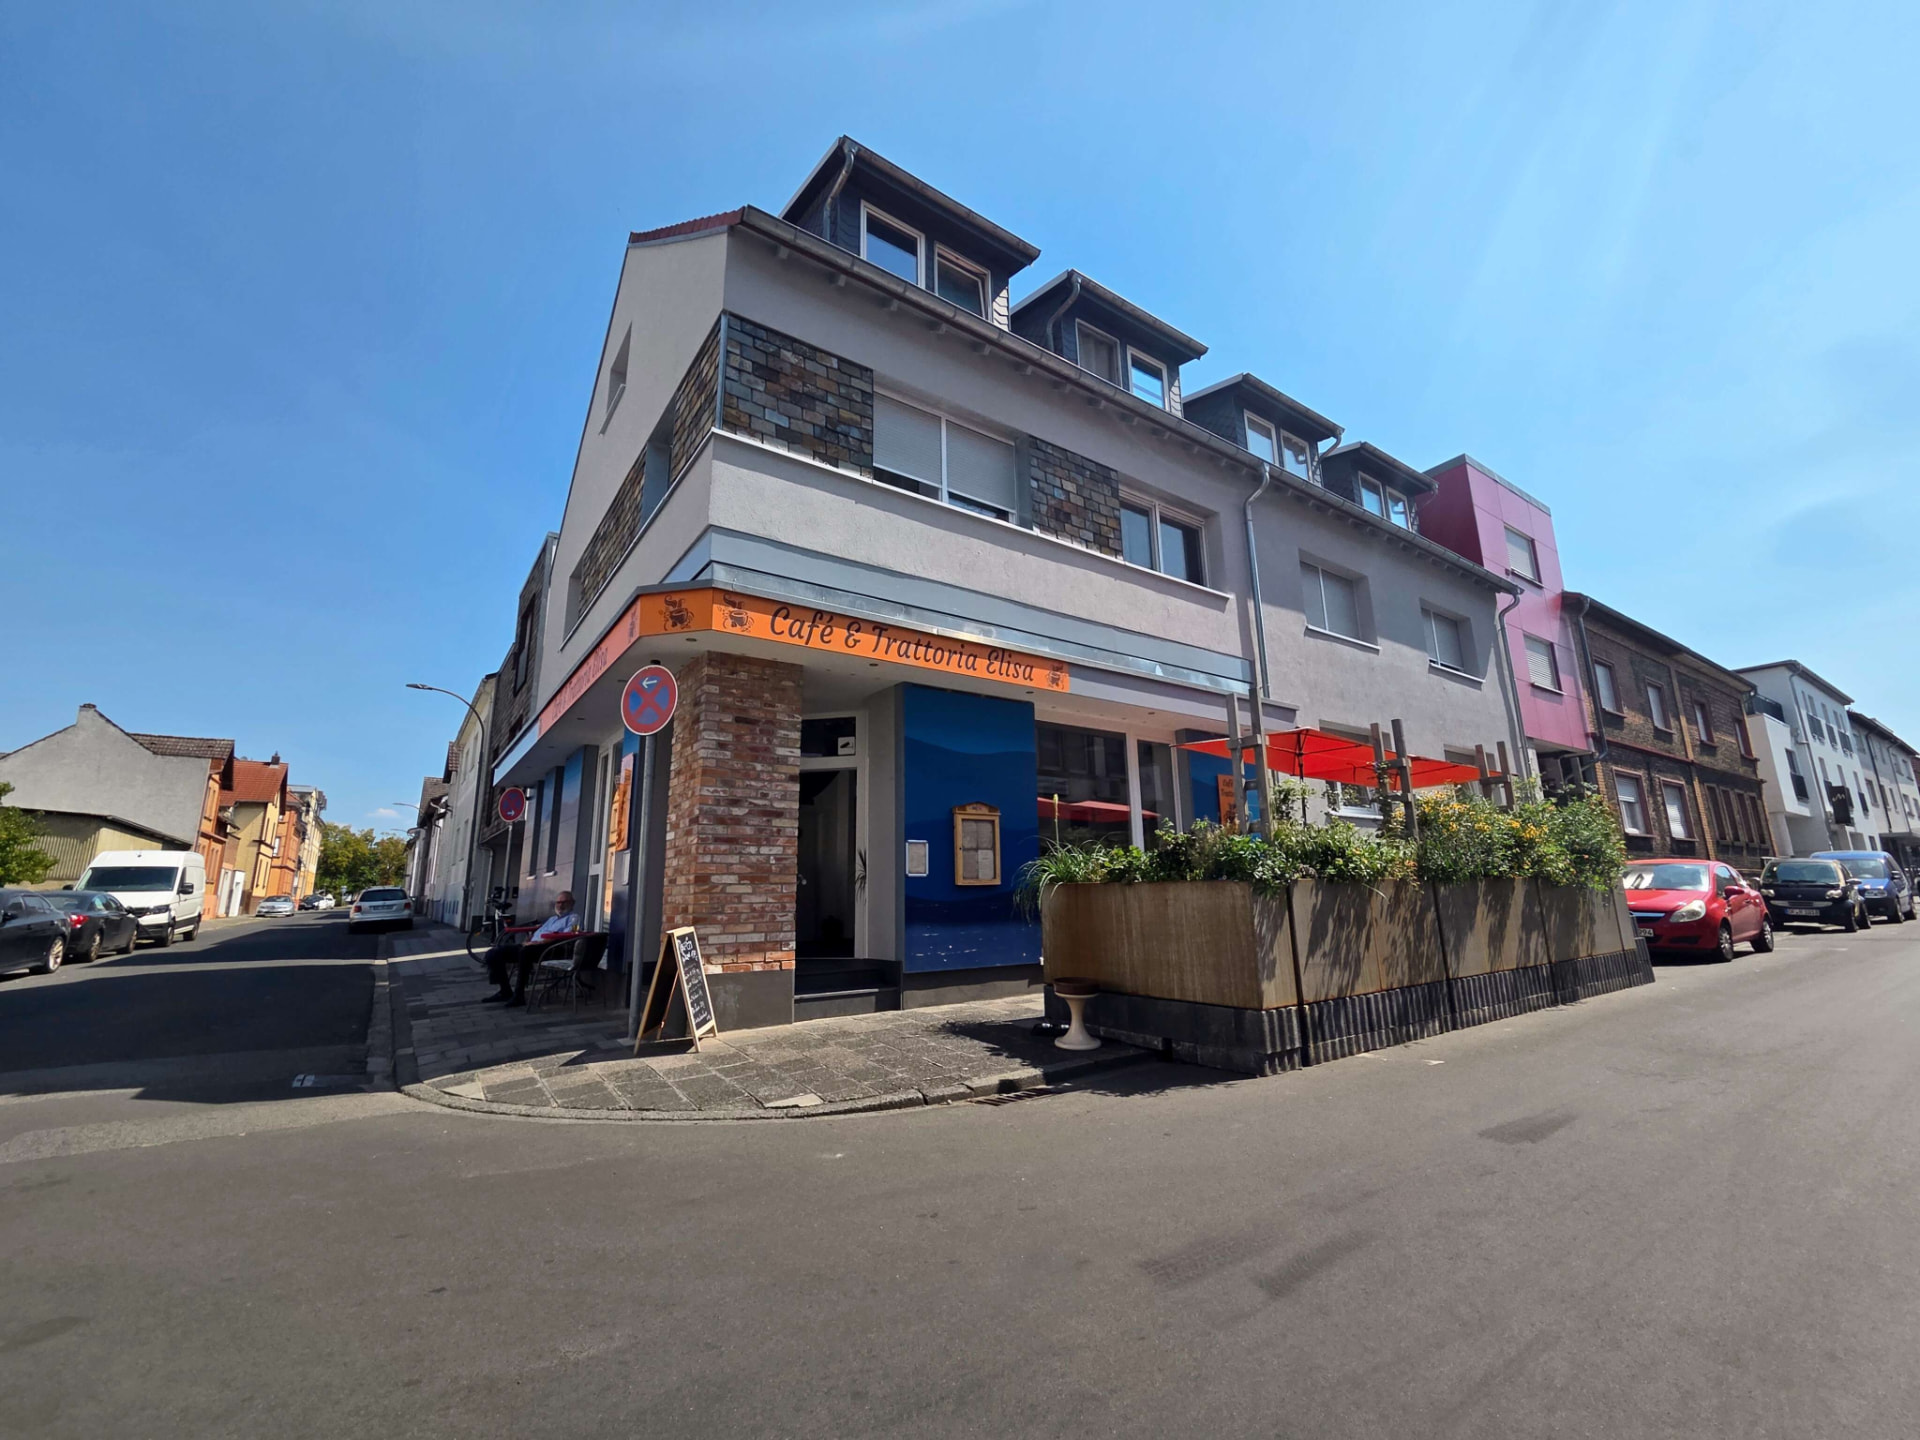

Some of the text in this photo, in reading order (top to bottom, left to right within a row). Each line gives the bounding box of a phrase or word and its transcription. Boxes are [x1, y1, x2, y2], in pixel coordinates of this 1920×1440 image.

[769, 606, 1035, 682] Café & Trattoria Elisa
